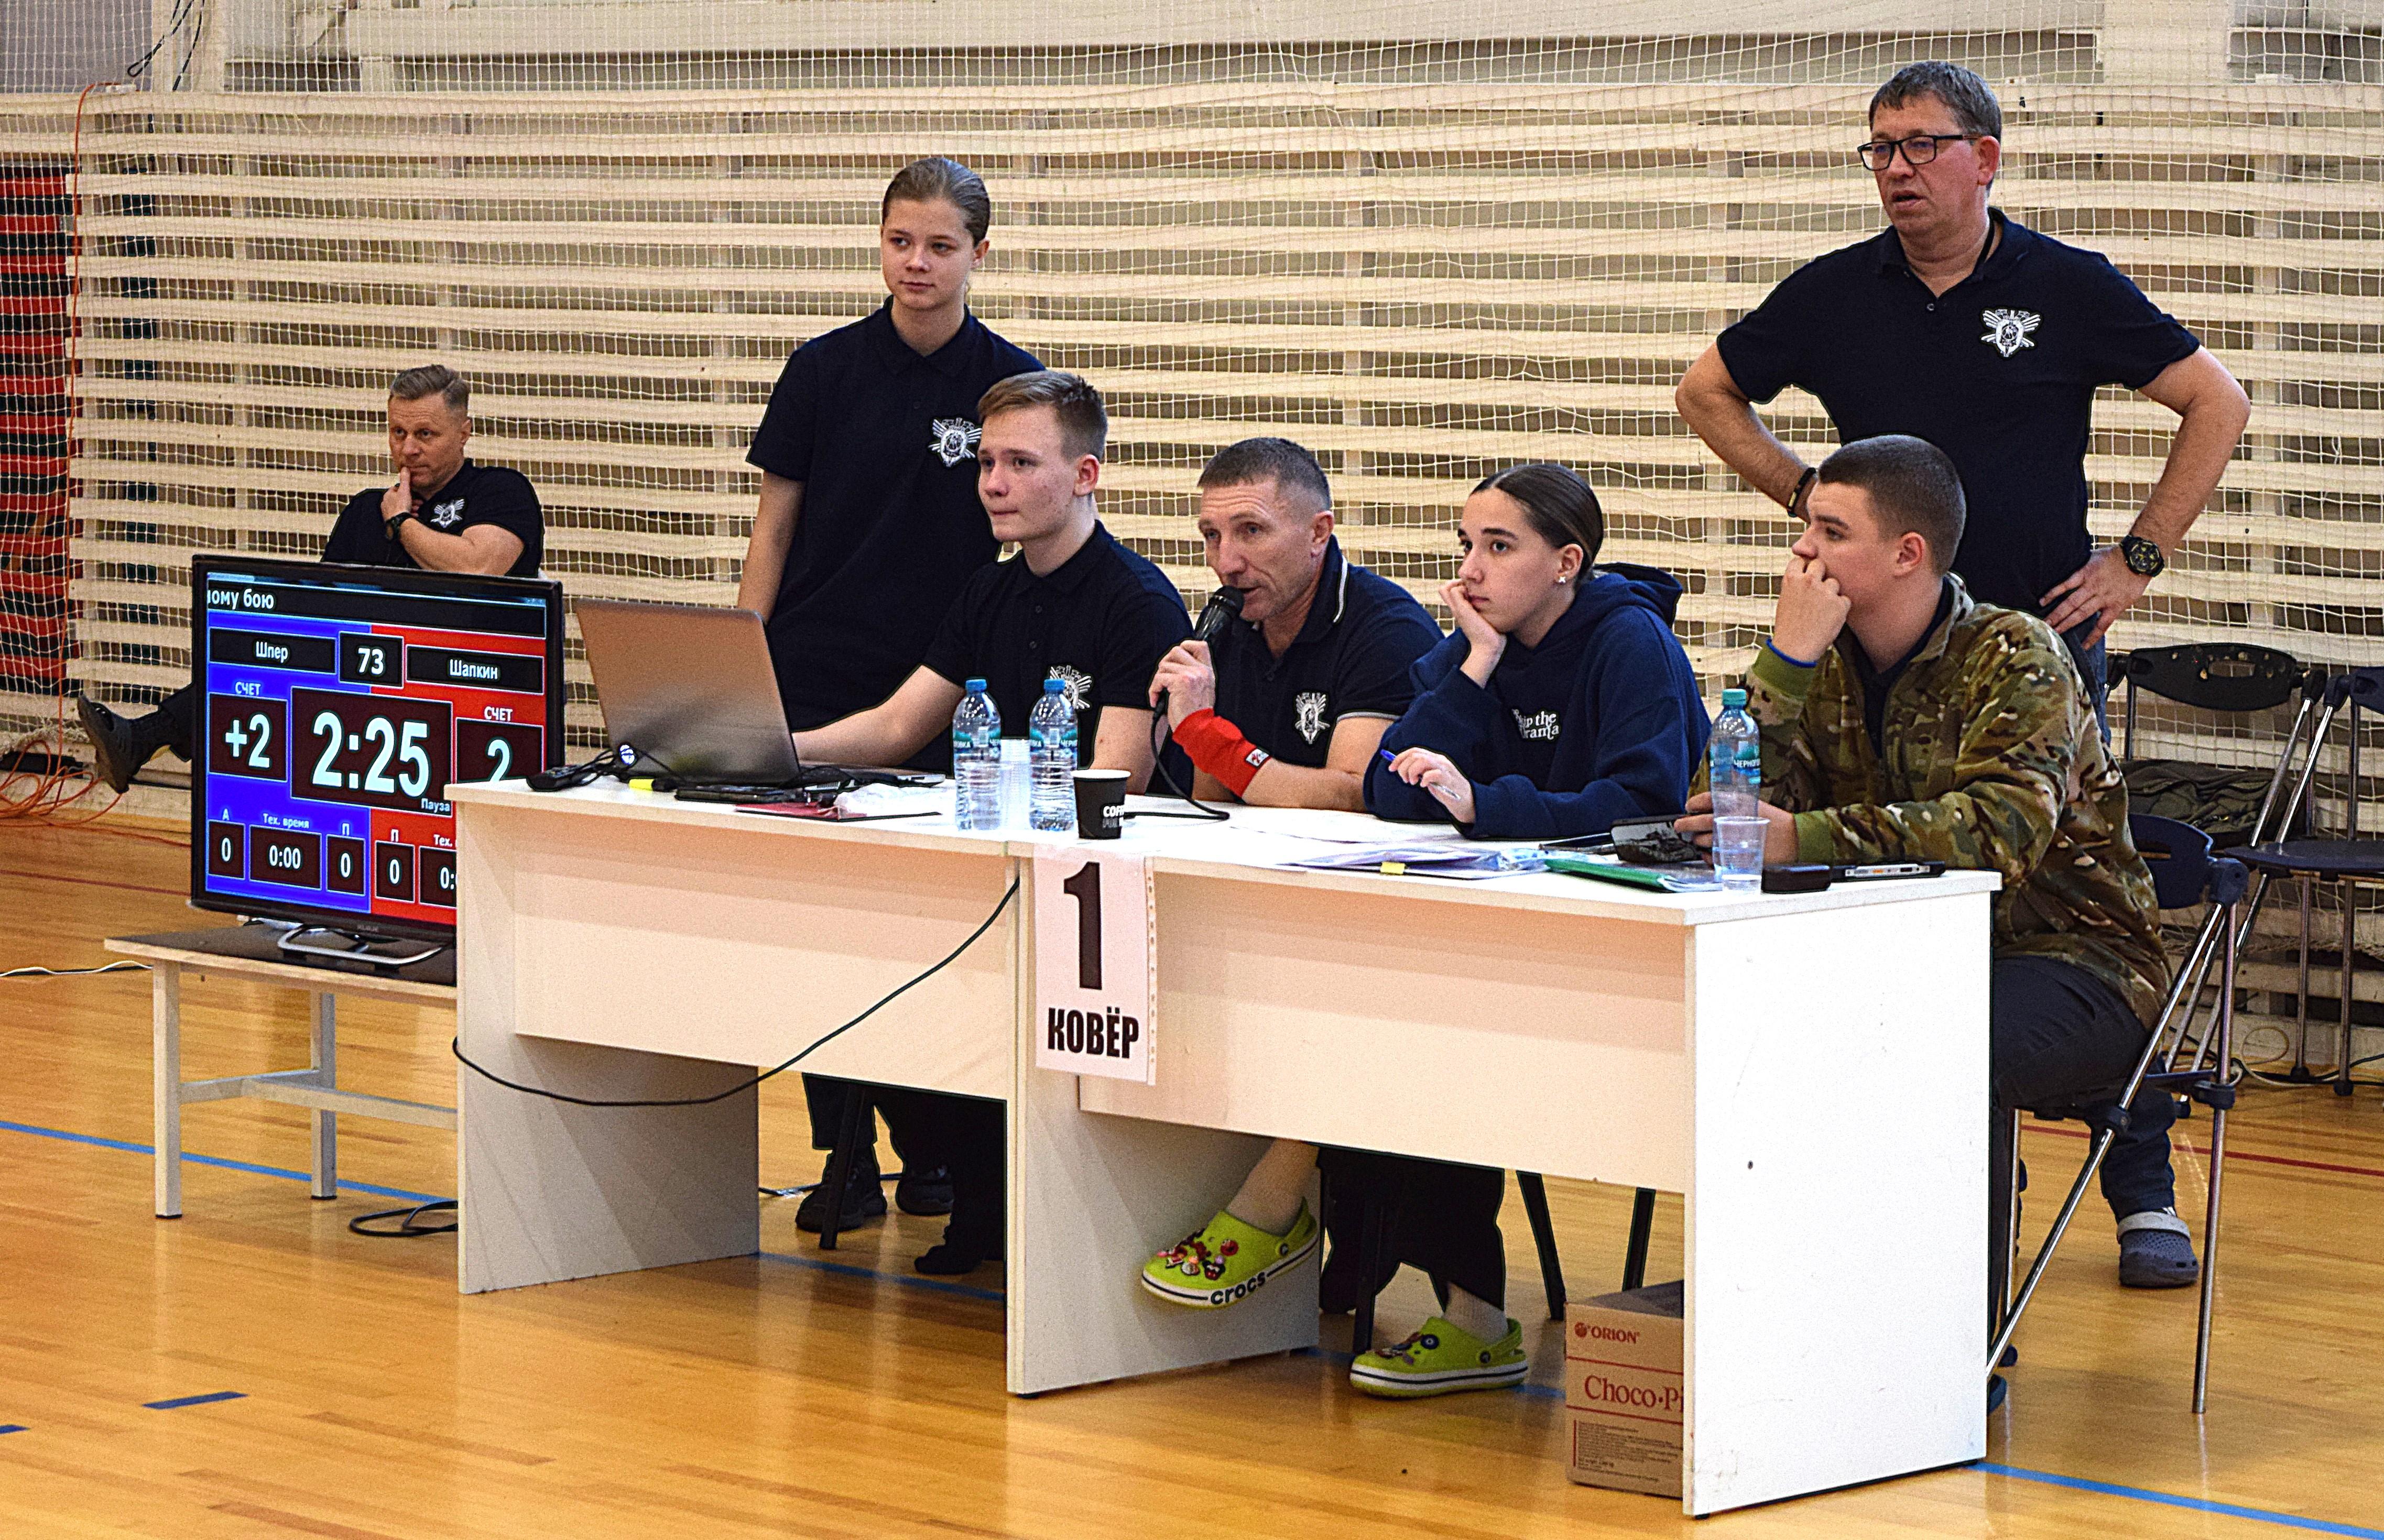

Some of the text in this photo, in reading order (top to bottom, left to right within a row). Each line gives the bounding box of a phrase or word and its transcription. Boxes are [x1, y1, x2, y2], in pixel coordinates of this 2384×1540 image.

[243, 588, 275, 609] бою
[256, 641, 289, 664] Шпер
[358, 647, 384, 675] 73
[449, 659, 498, 680] Шапкин
[235, 681, 261, 696] СЧЕТ
[484, 706, 513, 722] СЧЕТ
[1536, 711, 1557, 727] the
[225, 714, 270, 768] +2
[312, 712, 430, 797] 2:25
[487, 739, 510, 782] 2
[222, 808, 230, 821] А
[421, 798, 451, 813] Пауза
[263, 813, 310, 829] Тех. время
[342, 823, 350, 836] П
[390, 829, 399, 843] П
[433, 834, 453, 847] Тех.
[221, 837, 232, 862] 0
[269, 845, 301, 870] 0:00
[340, 853, 351, 878] 0
[389, 859, 400, 884] 0
[440, 867, 457, 890] 0:
[1064, 861, 1102, 990] 1
[1048, 1006, 1139, 1059] КОВЁР
[1210, 1272, 1266, 1305] crocs
[1591, 1326, 1637, 1345] ORION
